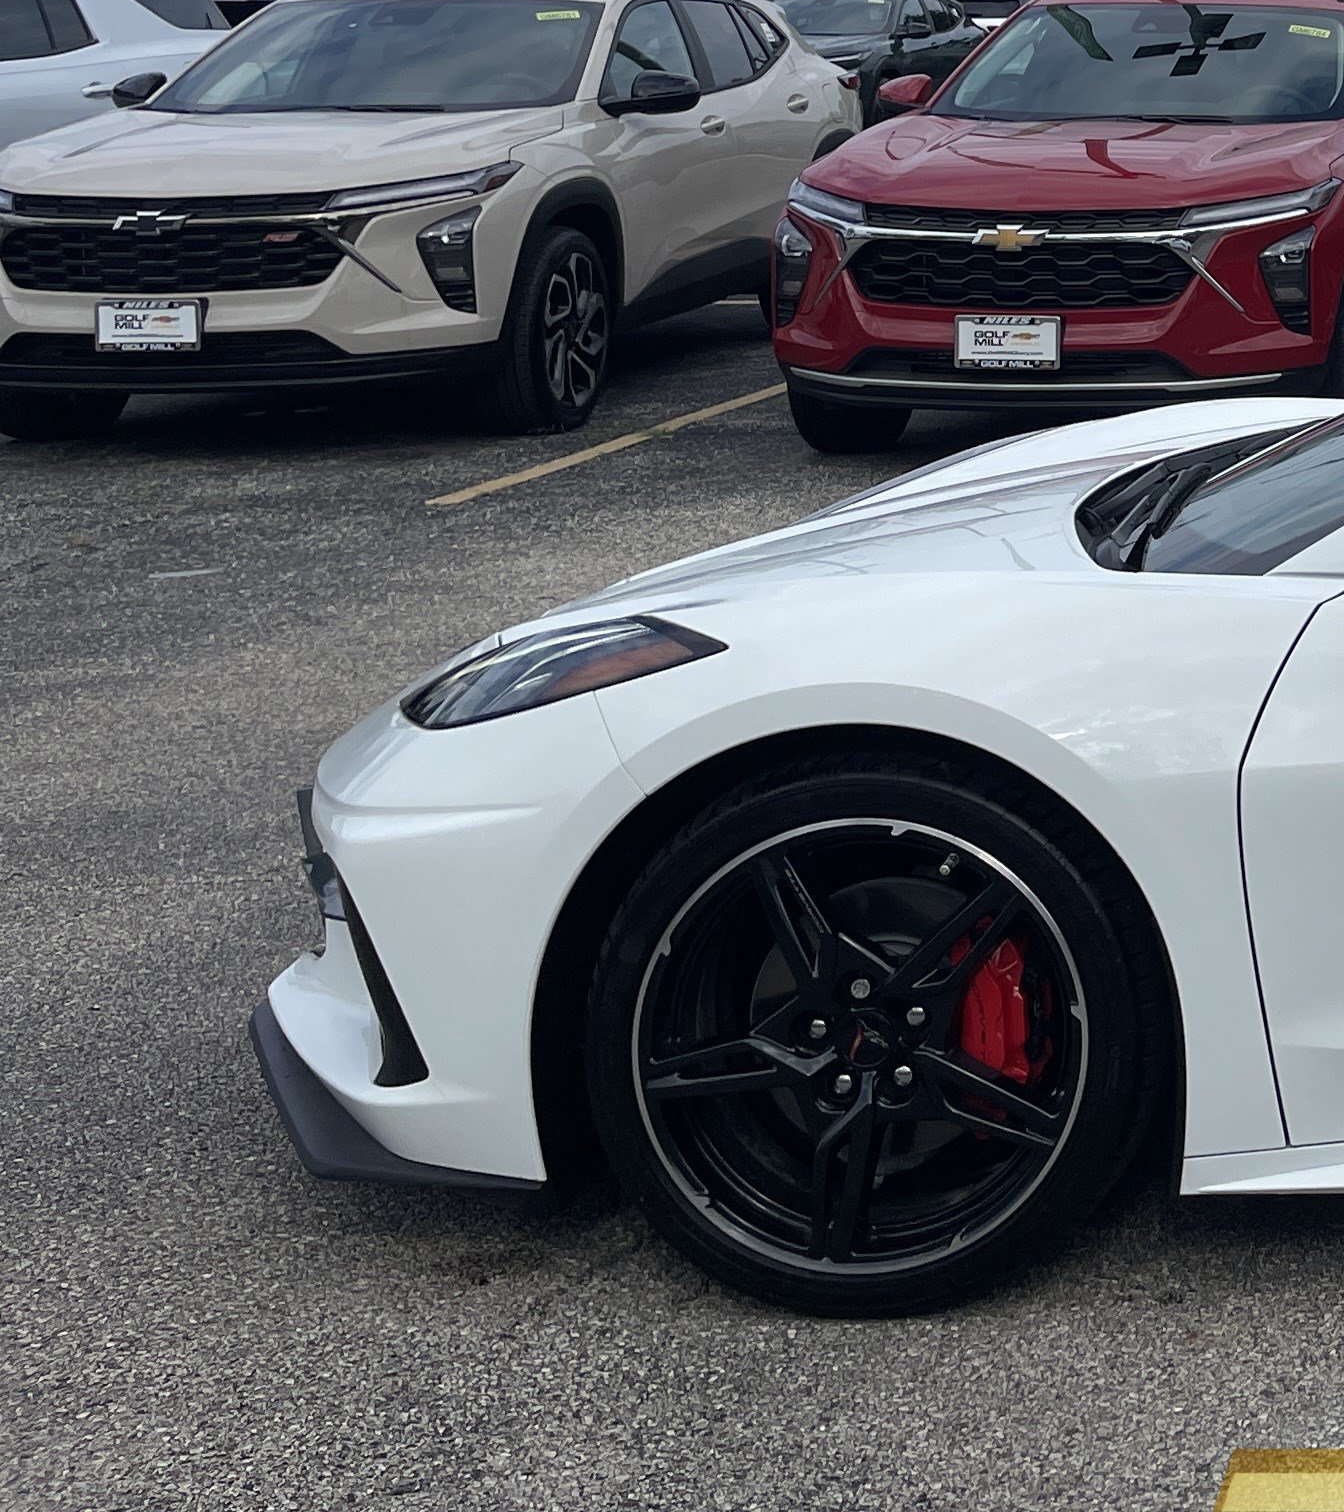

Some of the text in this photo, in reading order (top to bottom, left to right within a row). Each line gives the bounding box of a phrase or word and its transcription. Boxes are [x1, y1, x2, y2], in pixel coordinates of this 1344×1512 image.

[114, 313, 151, 322] GOLF
[983, 315, 1032, 324] NILES
[114, 321, 144, 330] MILL
[973, 330, 1011, 339] GOLF
[973, 338, 1004, 346] MILL
[121, 343, 176, 351] GOLF MILL
[980, 360, 1034, 368] GOLF MILL
